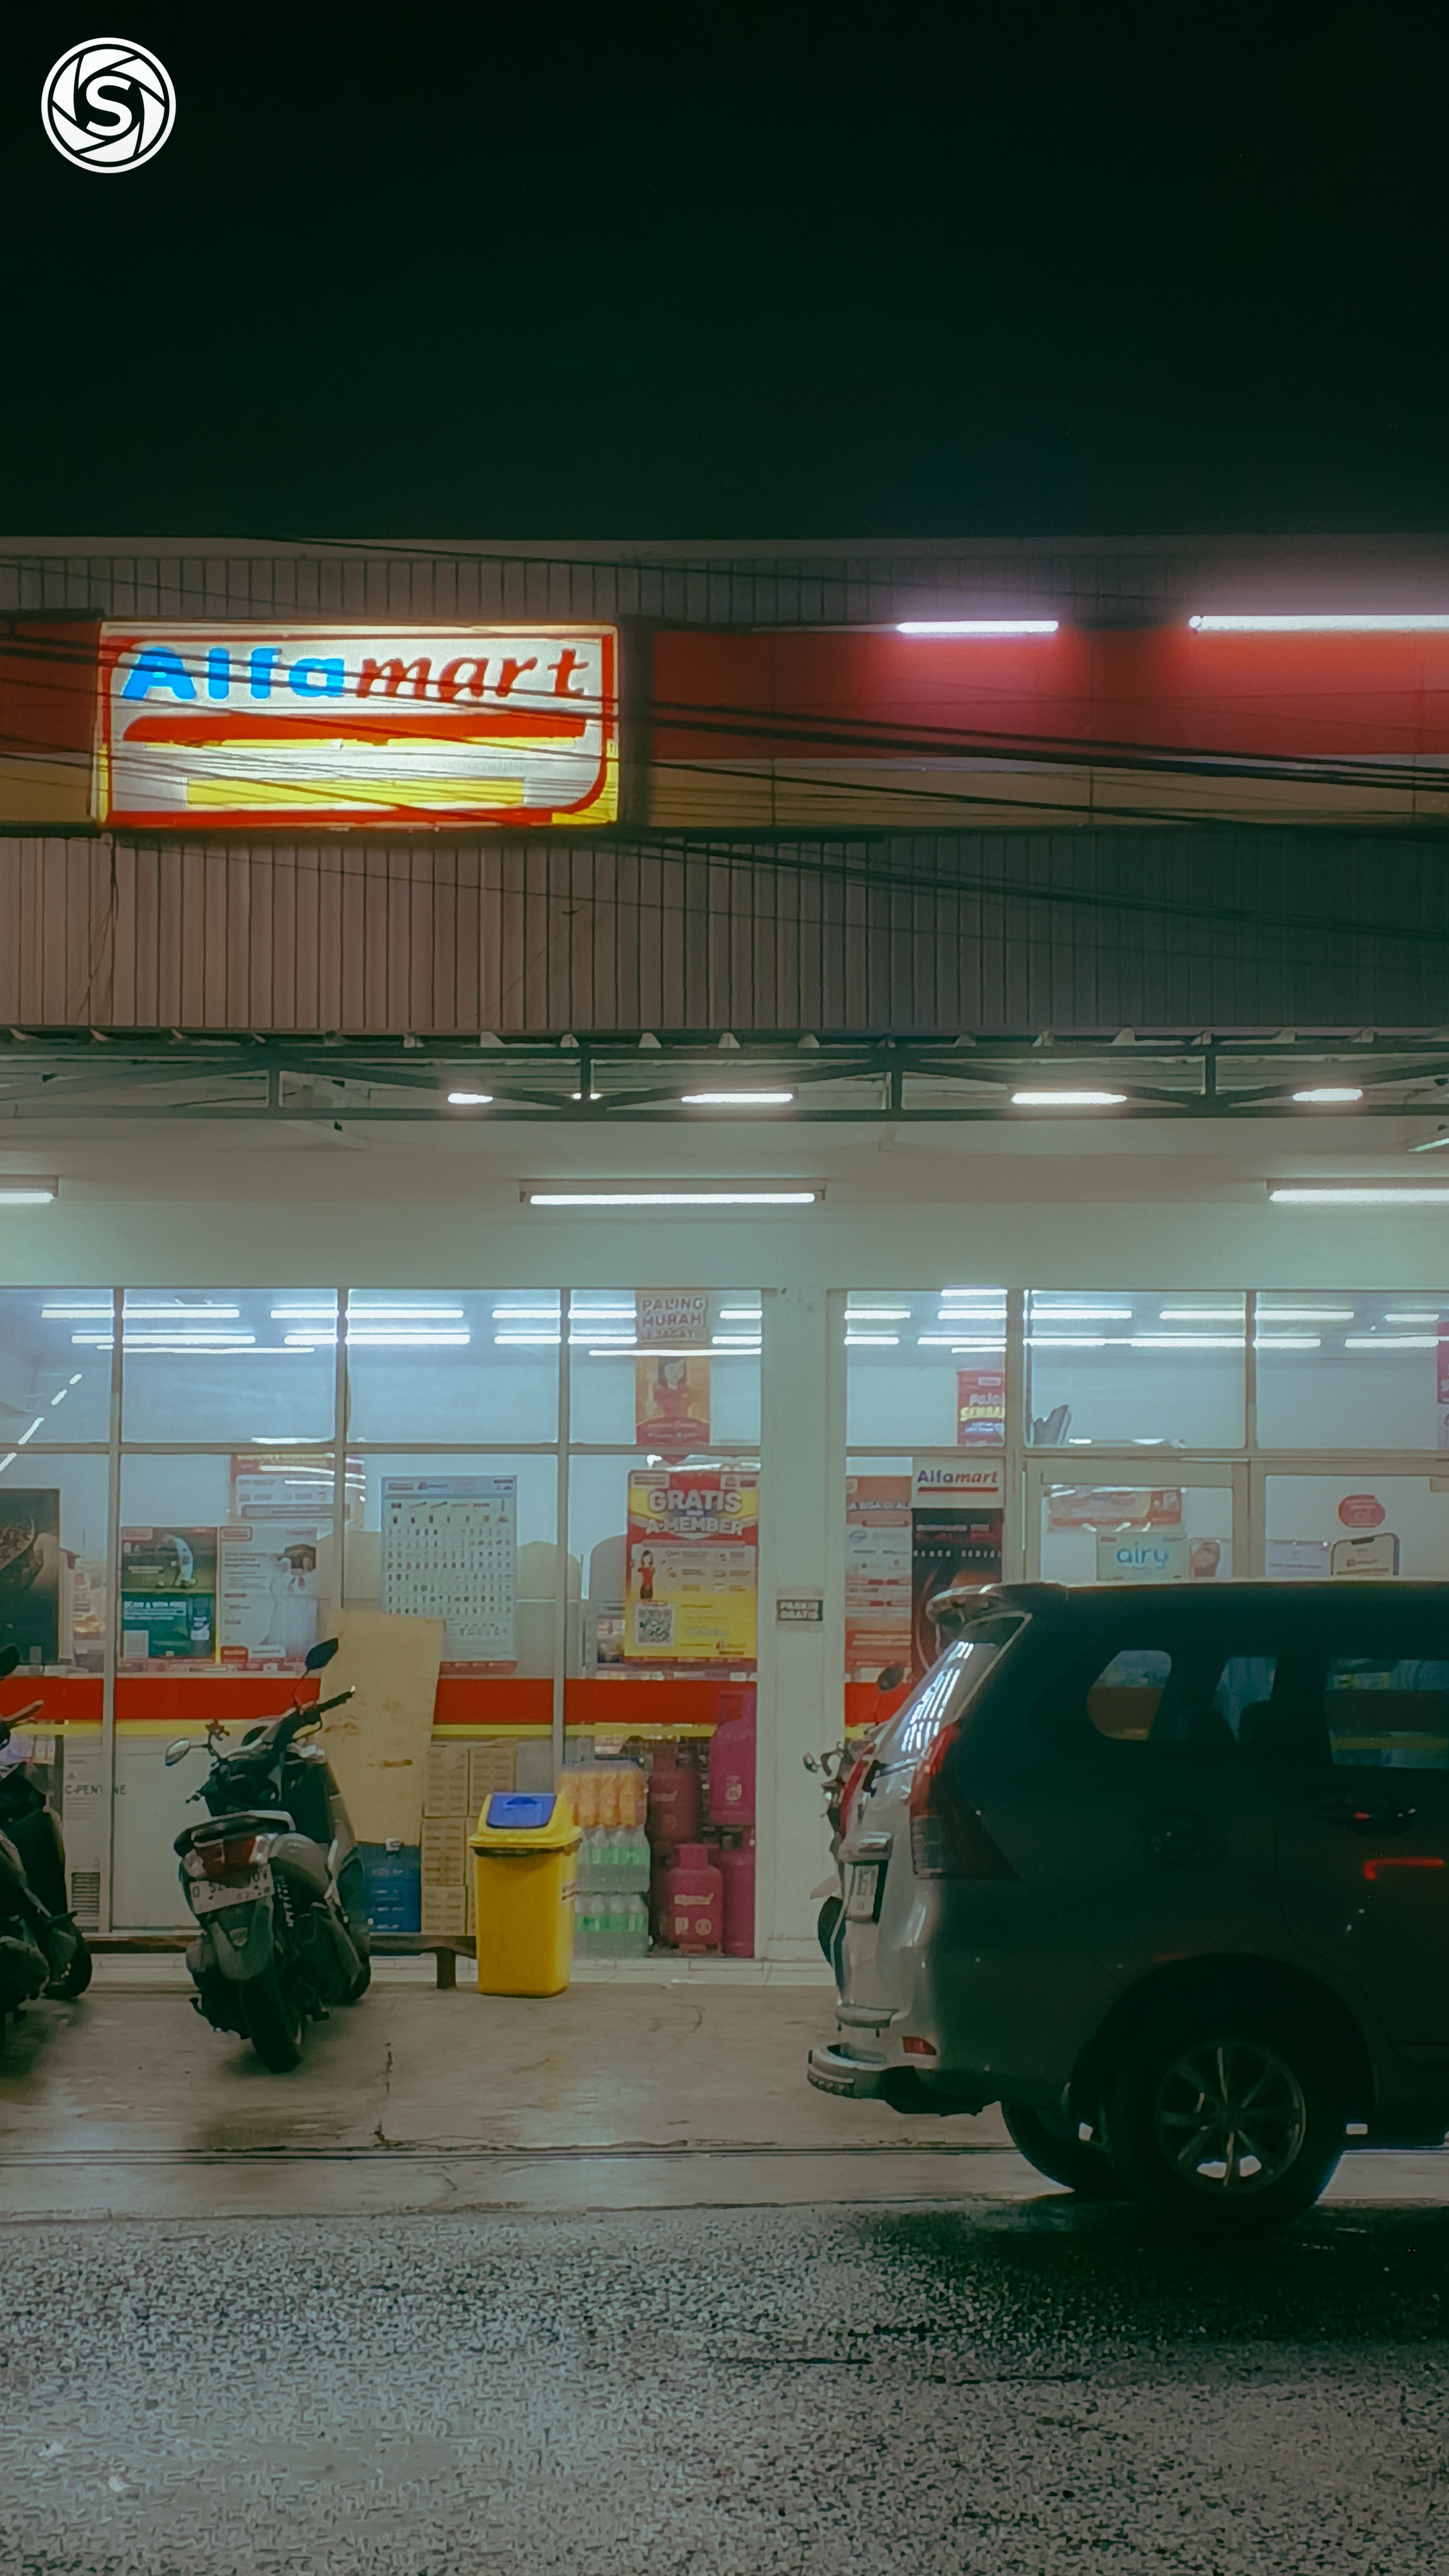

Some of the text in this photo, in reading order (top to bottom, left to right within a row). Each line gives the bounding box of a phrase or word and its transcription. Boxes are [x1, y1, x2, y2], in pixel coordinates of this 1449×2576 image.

[121, 646, 589, 701] Alfamart
[643, 1298, 704, 1310] PALING
[643, 1313, 702, 1327] MURAH
[918, 1470, 998, 1483] Alfamart
[650, 1490, 743, 1512] GRATIS
[1116, 1541, 1169, 1570] airy
